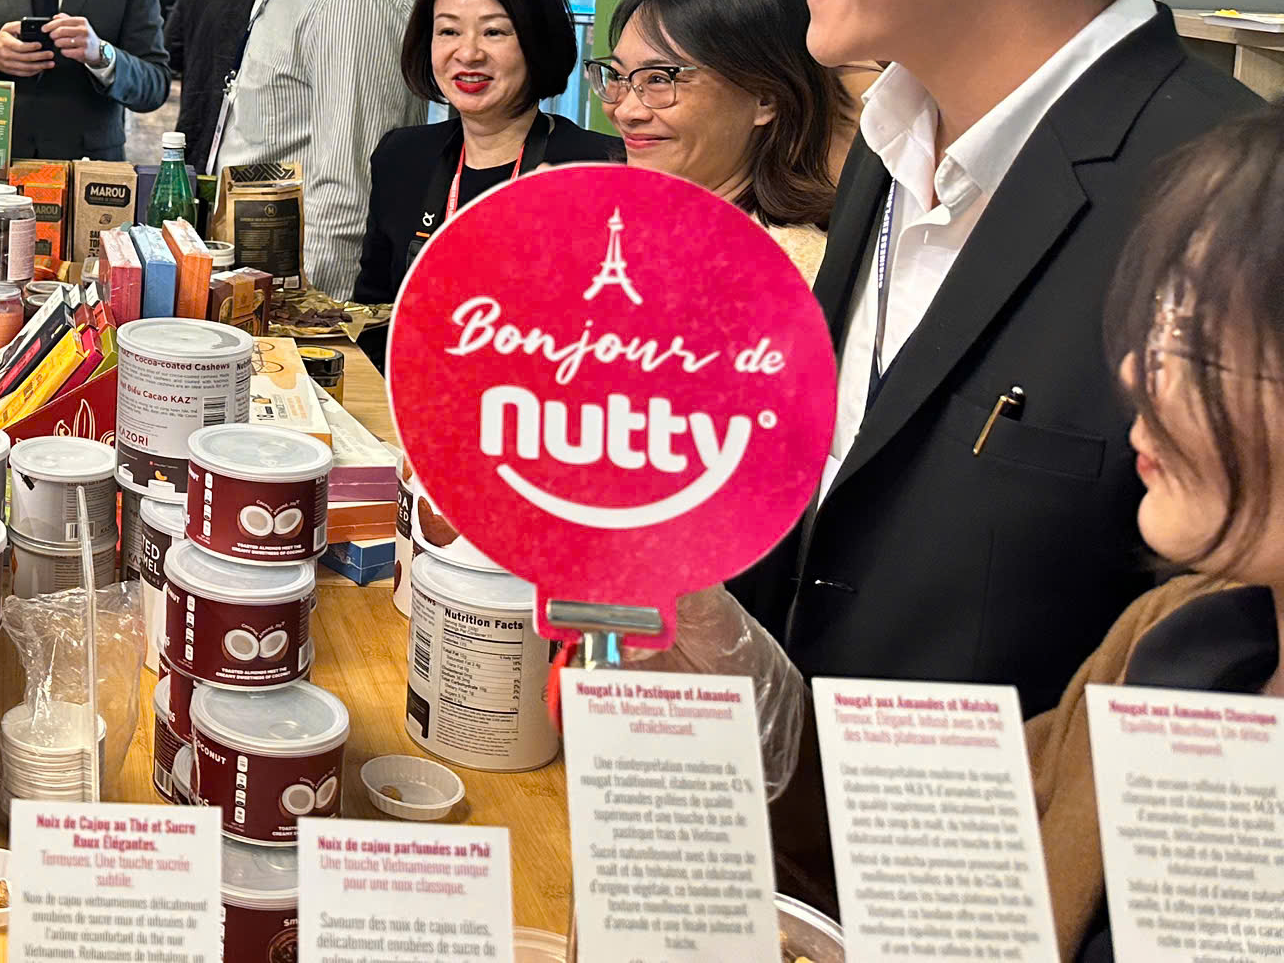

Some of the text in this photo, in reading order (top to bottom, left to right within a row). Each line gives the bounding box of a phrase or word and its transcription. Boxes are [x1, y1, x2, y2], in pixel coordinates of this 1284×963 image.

[90, 186, 125, 198] MAROU
[36, 206, 58, 214] AROU
[445, 296, 786, 385] Bonjour de
[134, 354, 230, 371] Cocoa-coated Cashews
[143, 391, 168, 402] Cacao
[119, 427, 148, 446] KAZORI
[445, 608, 524, 630] Nutrition Facts
[576, 682, 612, 696] Nougat
[615, 683, 622, 697] à
[624, 684, 633, 697] la
[684, 686, 695, 701] et
[696, 688, 741, 703] Amandes
[834, 692, 872, 709] Nougat
[36, 814, 195, 835] Noix de Cajou au Thé et Sucre
[73, 834, 158, 853] Roux Élégantes.
[317, 836, 342, 850] Noix
[345, 838, 357, 851] de
[361, 839, 390, 854] cajou
[394, 839, 451, 857] parfumées
[454, 845, 467, 856] au
[95, 852, 115, 869] Une
[118, 853, 154, 870] touche
[156, 856, 190, 872] sucrée
[344, 855, 379, 872] touche
[382, 857, 451, 876] Vietnamienne
[343, 875, 466, 896] pour une noix classique.
